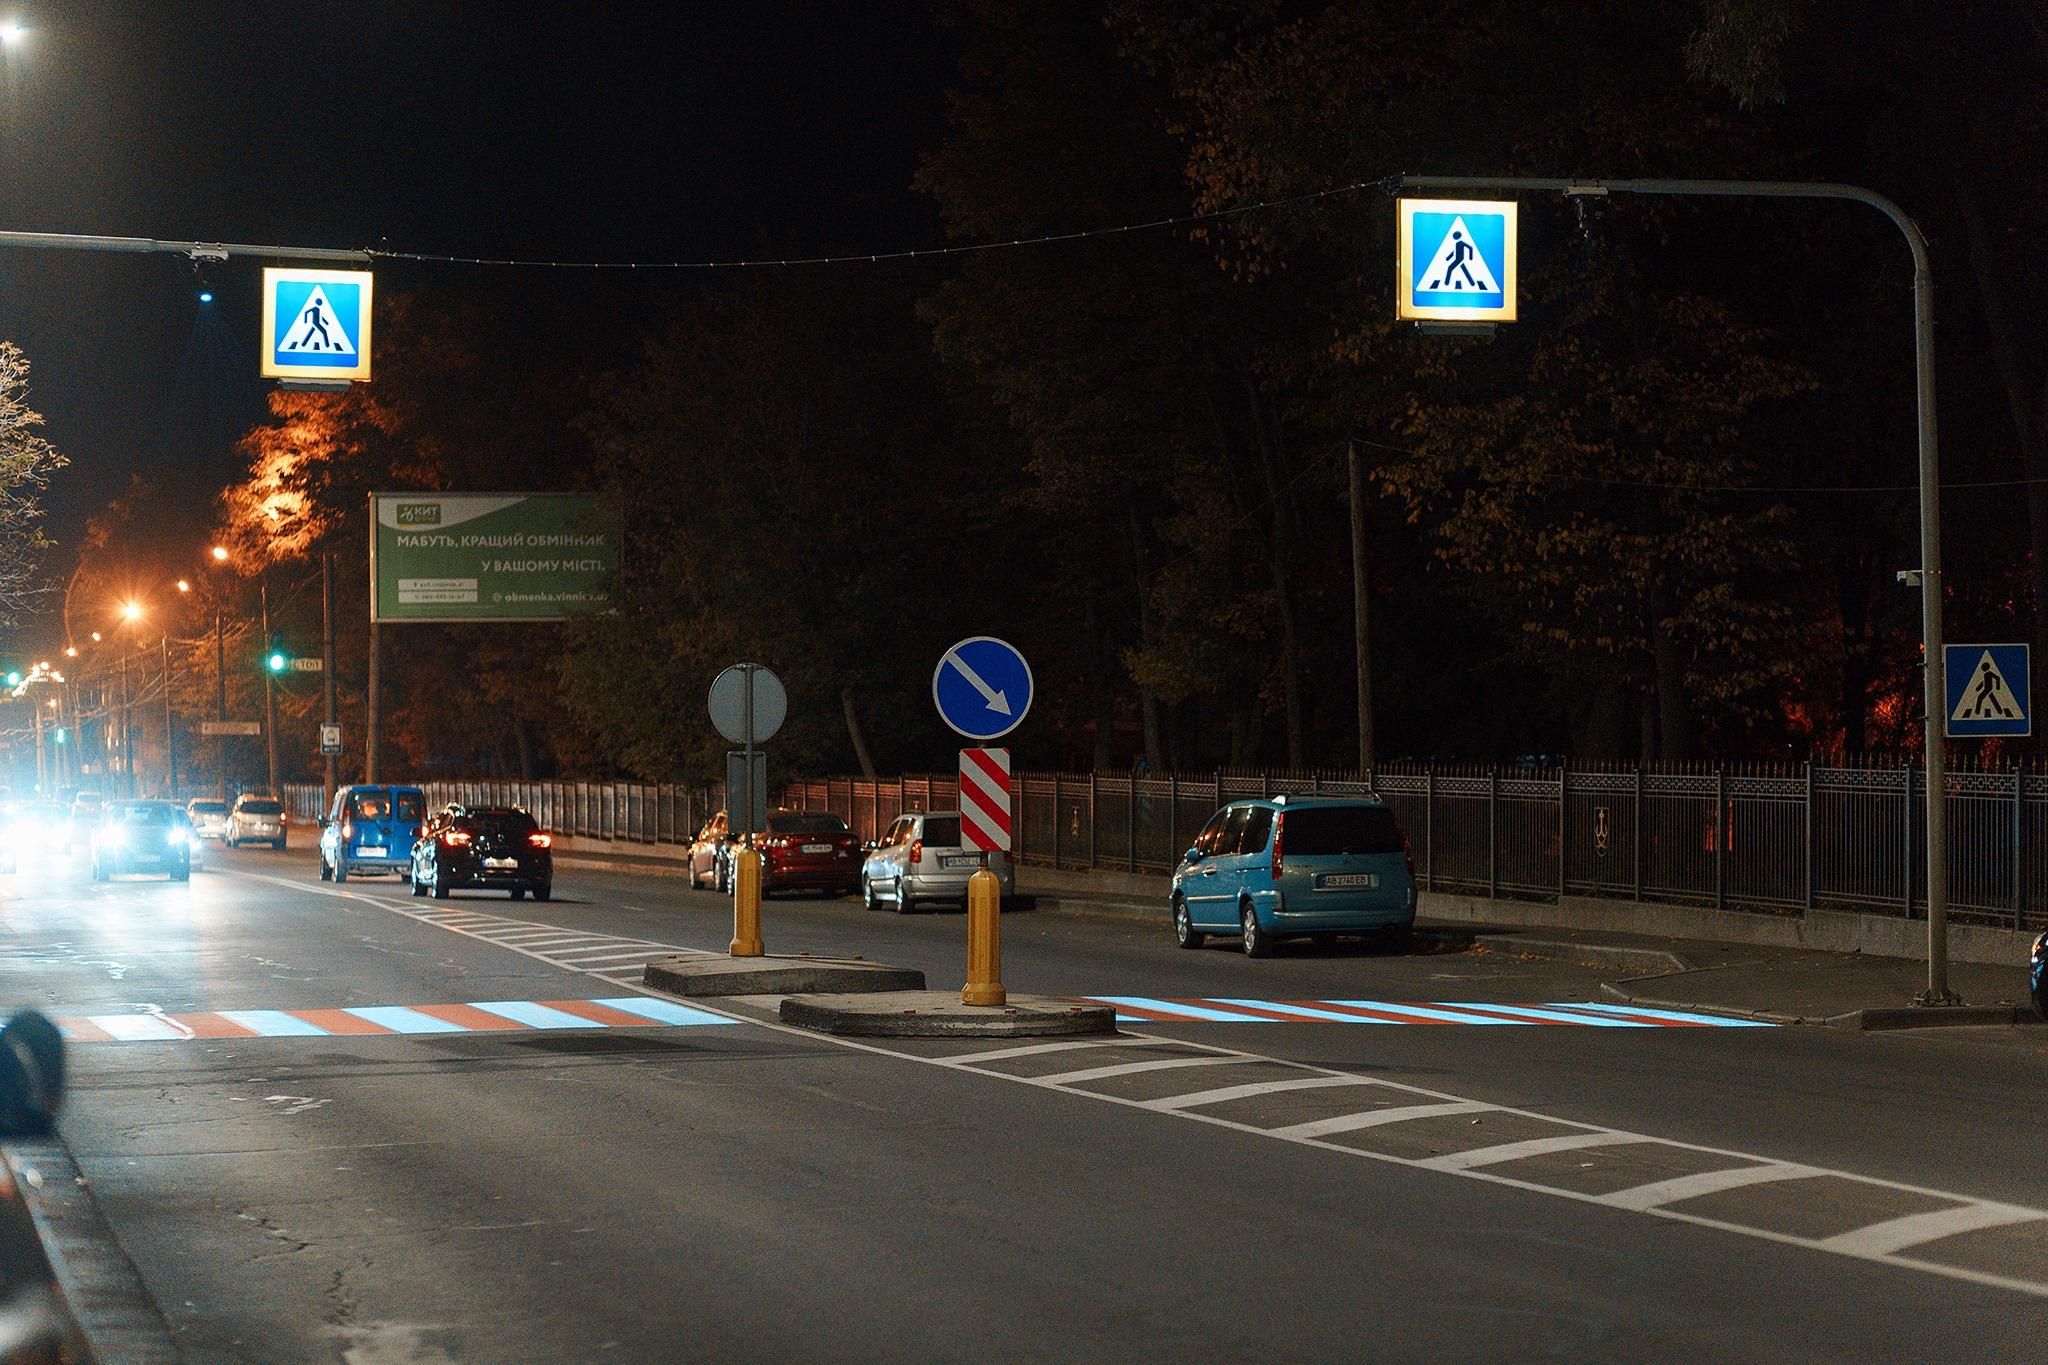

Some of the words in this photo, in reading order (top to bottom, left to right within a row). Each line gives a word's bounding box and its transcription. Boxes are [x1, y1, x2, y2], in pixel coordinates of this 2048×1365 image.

[397, 535, 459, 548] МАБУТЬ,
[461, 532, 524, 548] КРАЩИЙ
[481, 560, 490, 572] У
[494, 559, 559, 572] ВАШОМУ
[562, 559, 606, 572] МІСТІ.
